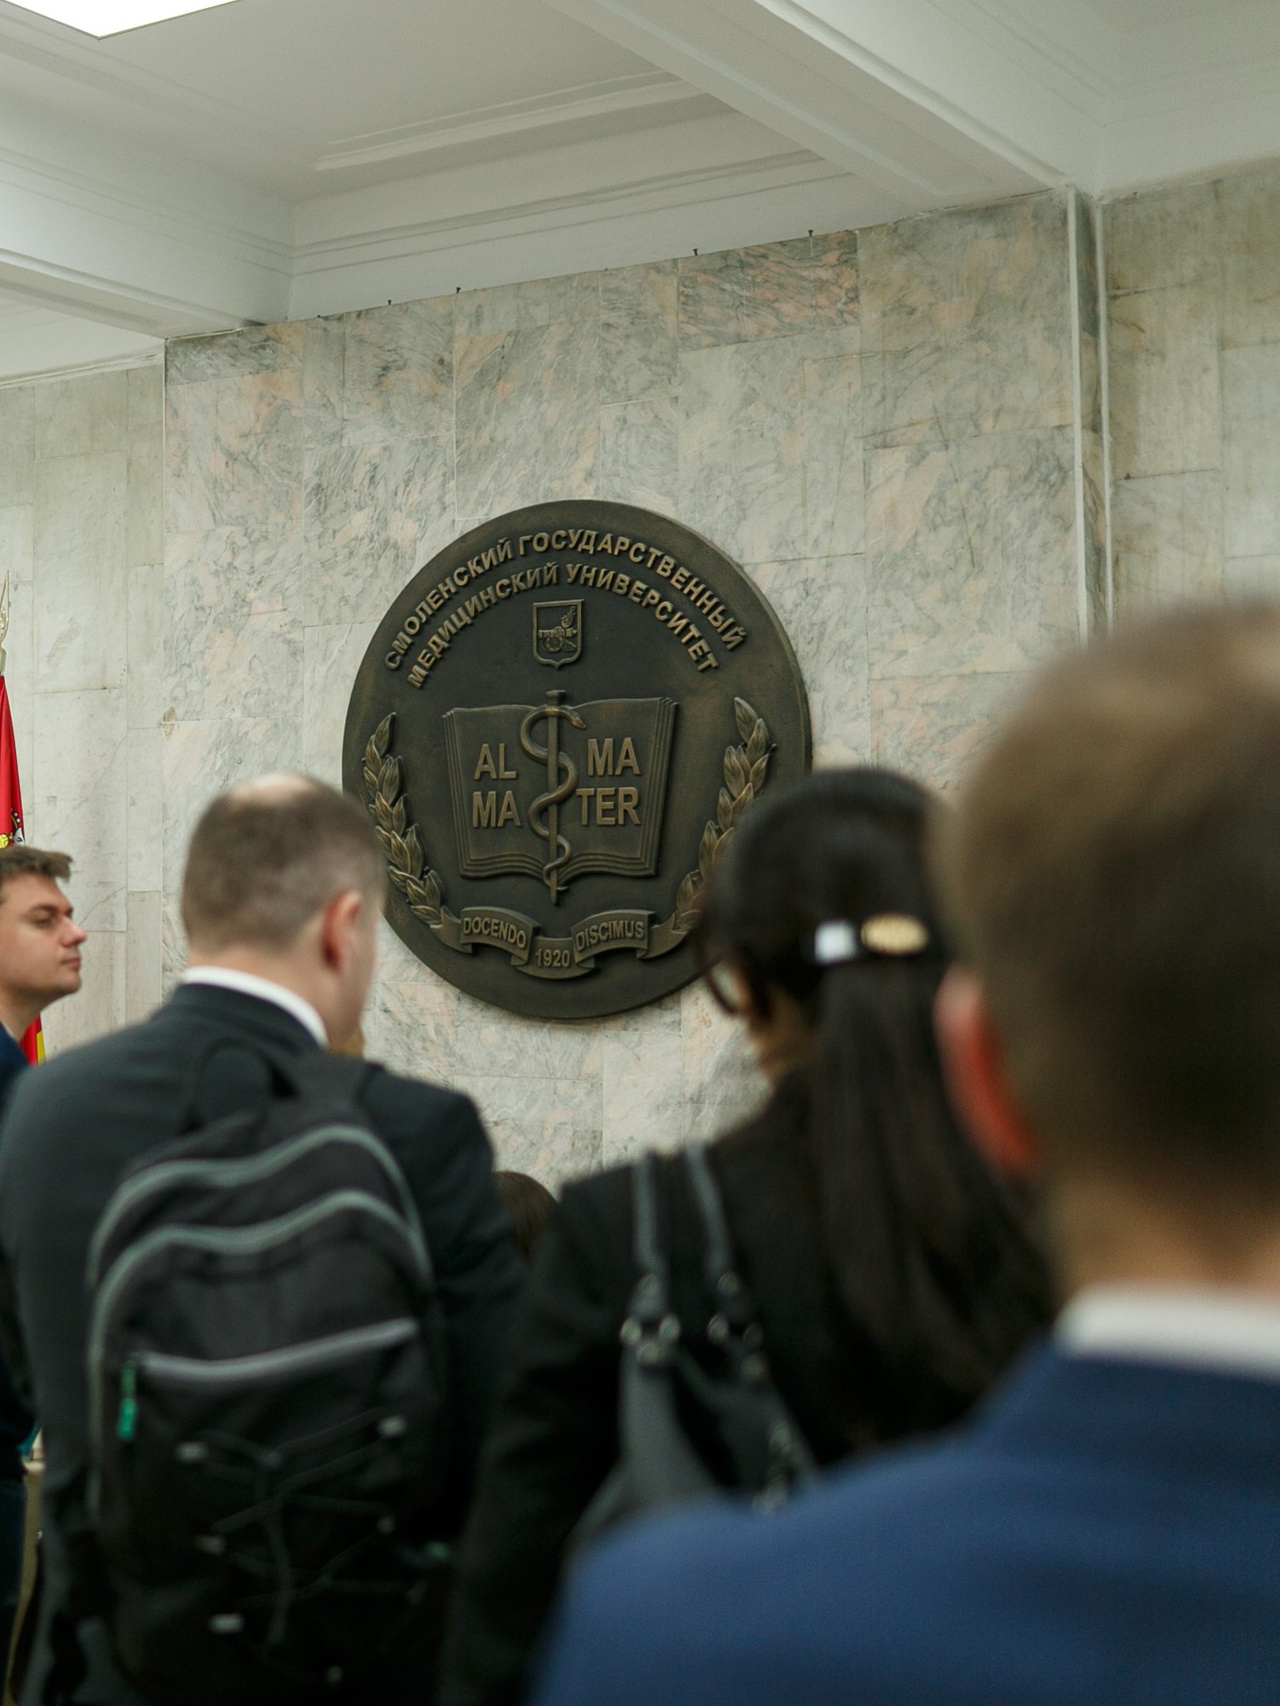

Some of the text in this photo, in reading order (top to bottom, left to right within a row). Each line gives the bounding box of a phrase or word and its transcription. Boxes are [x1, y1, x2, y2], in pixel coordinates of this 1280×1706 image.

[384, 529, 747, 670] СМОЛЕНСКИЙ ГОСУДАРСТВЕННЫЙ
[407, 561, 719, 688] МЕДИЦИНСКИЙ УНИВЕРСИТЕТ
[473, 737, 641, 780] AL MA
[472, 786, 641, 828] MA TER
[463, 916, 645, 951] DOCENDO DISCIMUS
[534, 948, 570, 968] 1920
